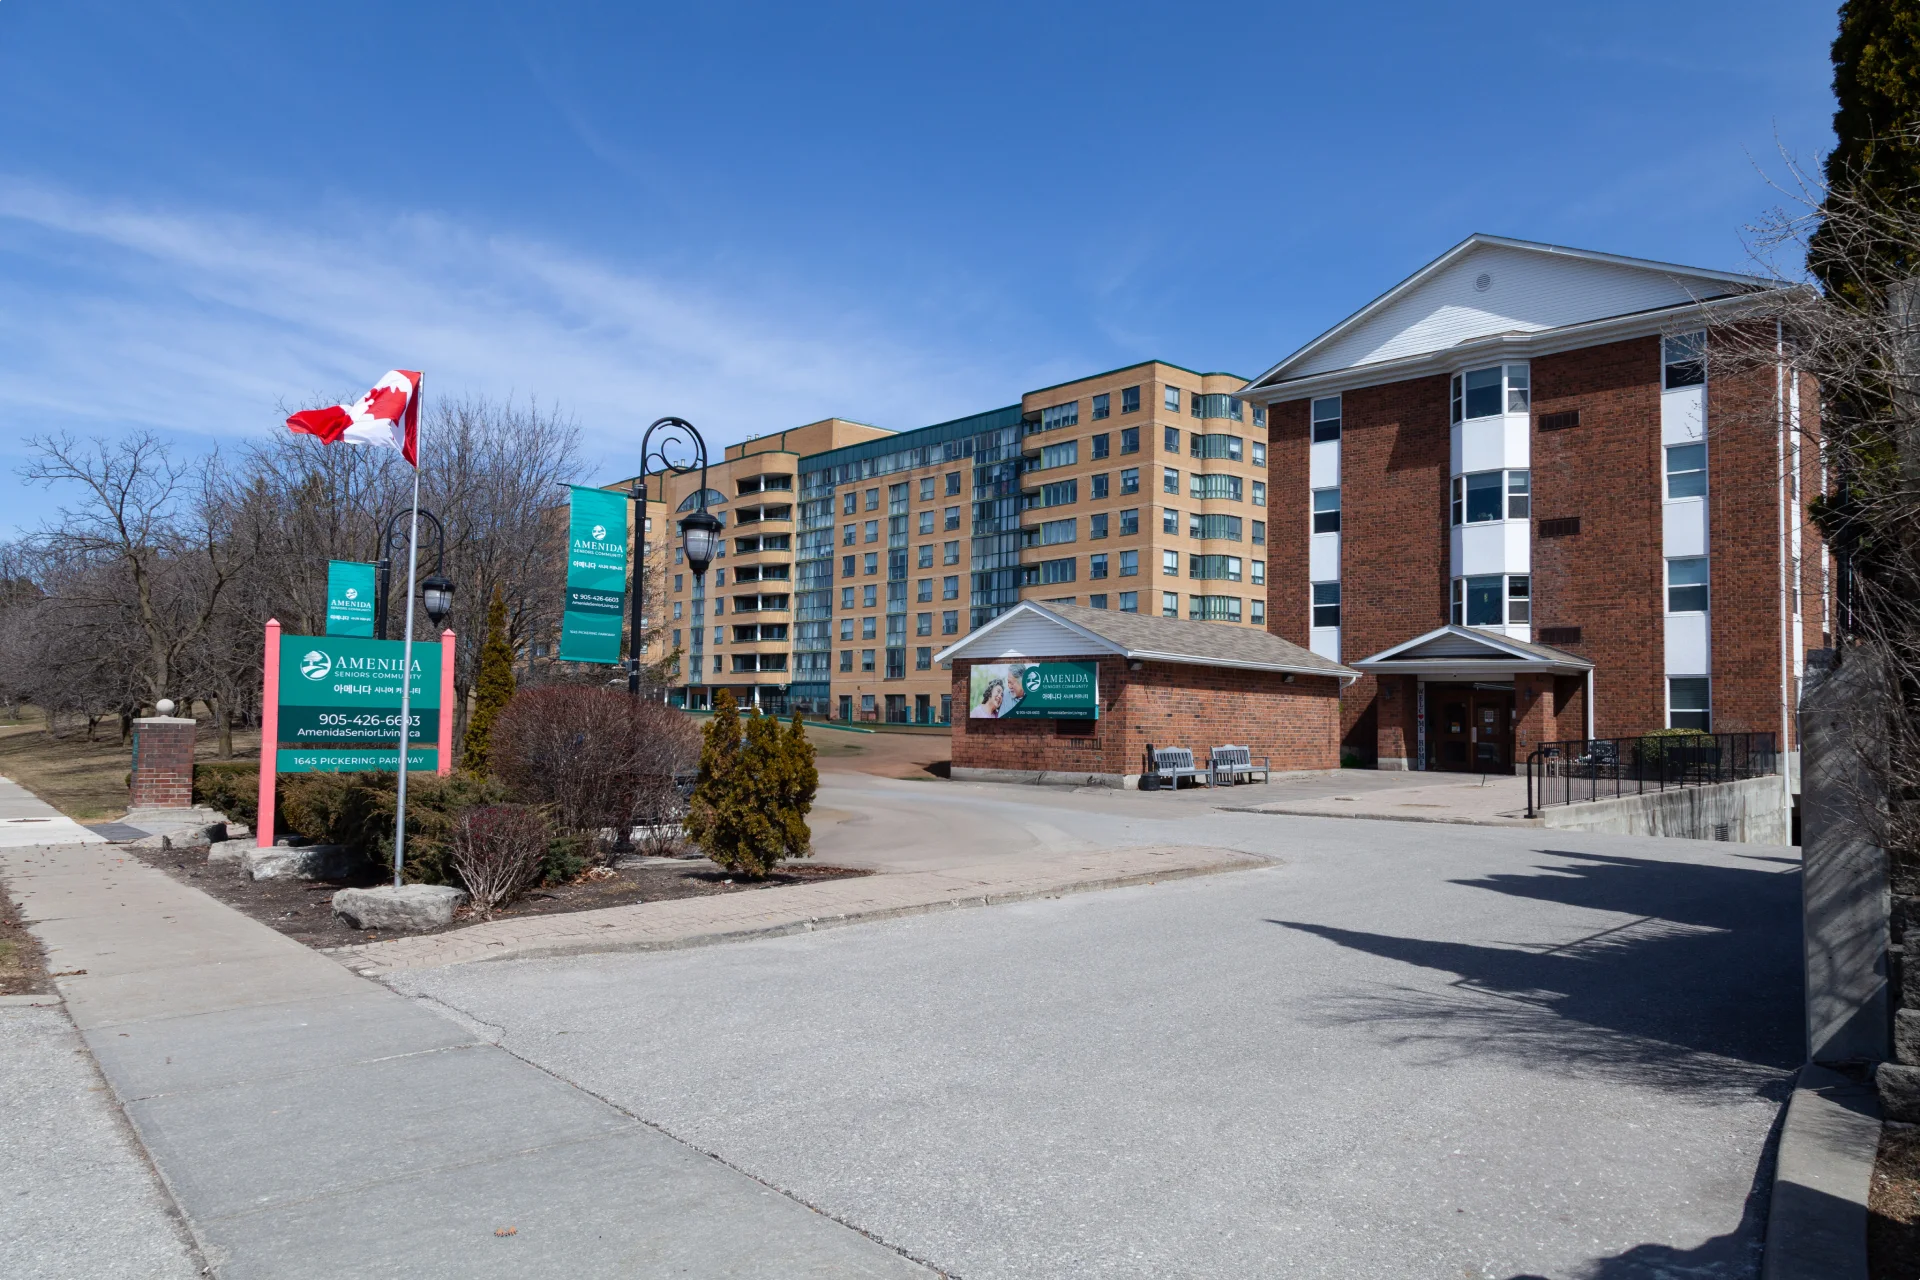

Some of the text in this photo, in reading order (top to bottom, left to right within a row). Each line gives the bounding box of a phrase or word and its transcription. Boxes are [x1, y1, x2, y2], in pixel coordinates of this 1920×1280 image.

[574, 539, 623, 553] AMENIDA
[580, 594, 619, 603] 905-426-6603
[331, 599, 371, 608] AMENIDA
[335, 656, 422, 672] AMENIDA
[1043, 674, 1088, 683] AMENIDA
[334, 684, 371, 694] 아메니다
[297, 728, 420, 737] AmenidaSeniorLivinca
